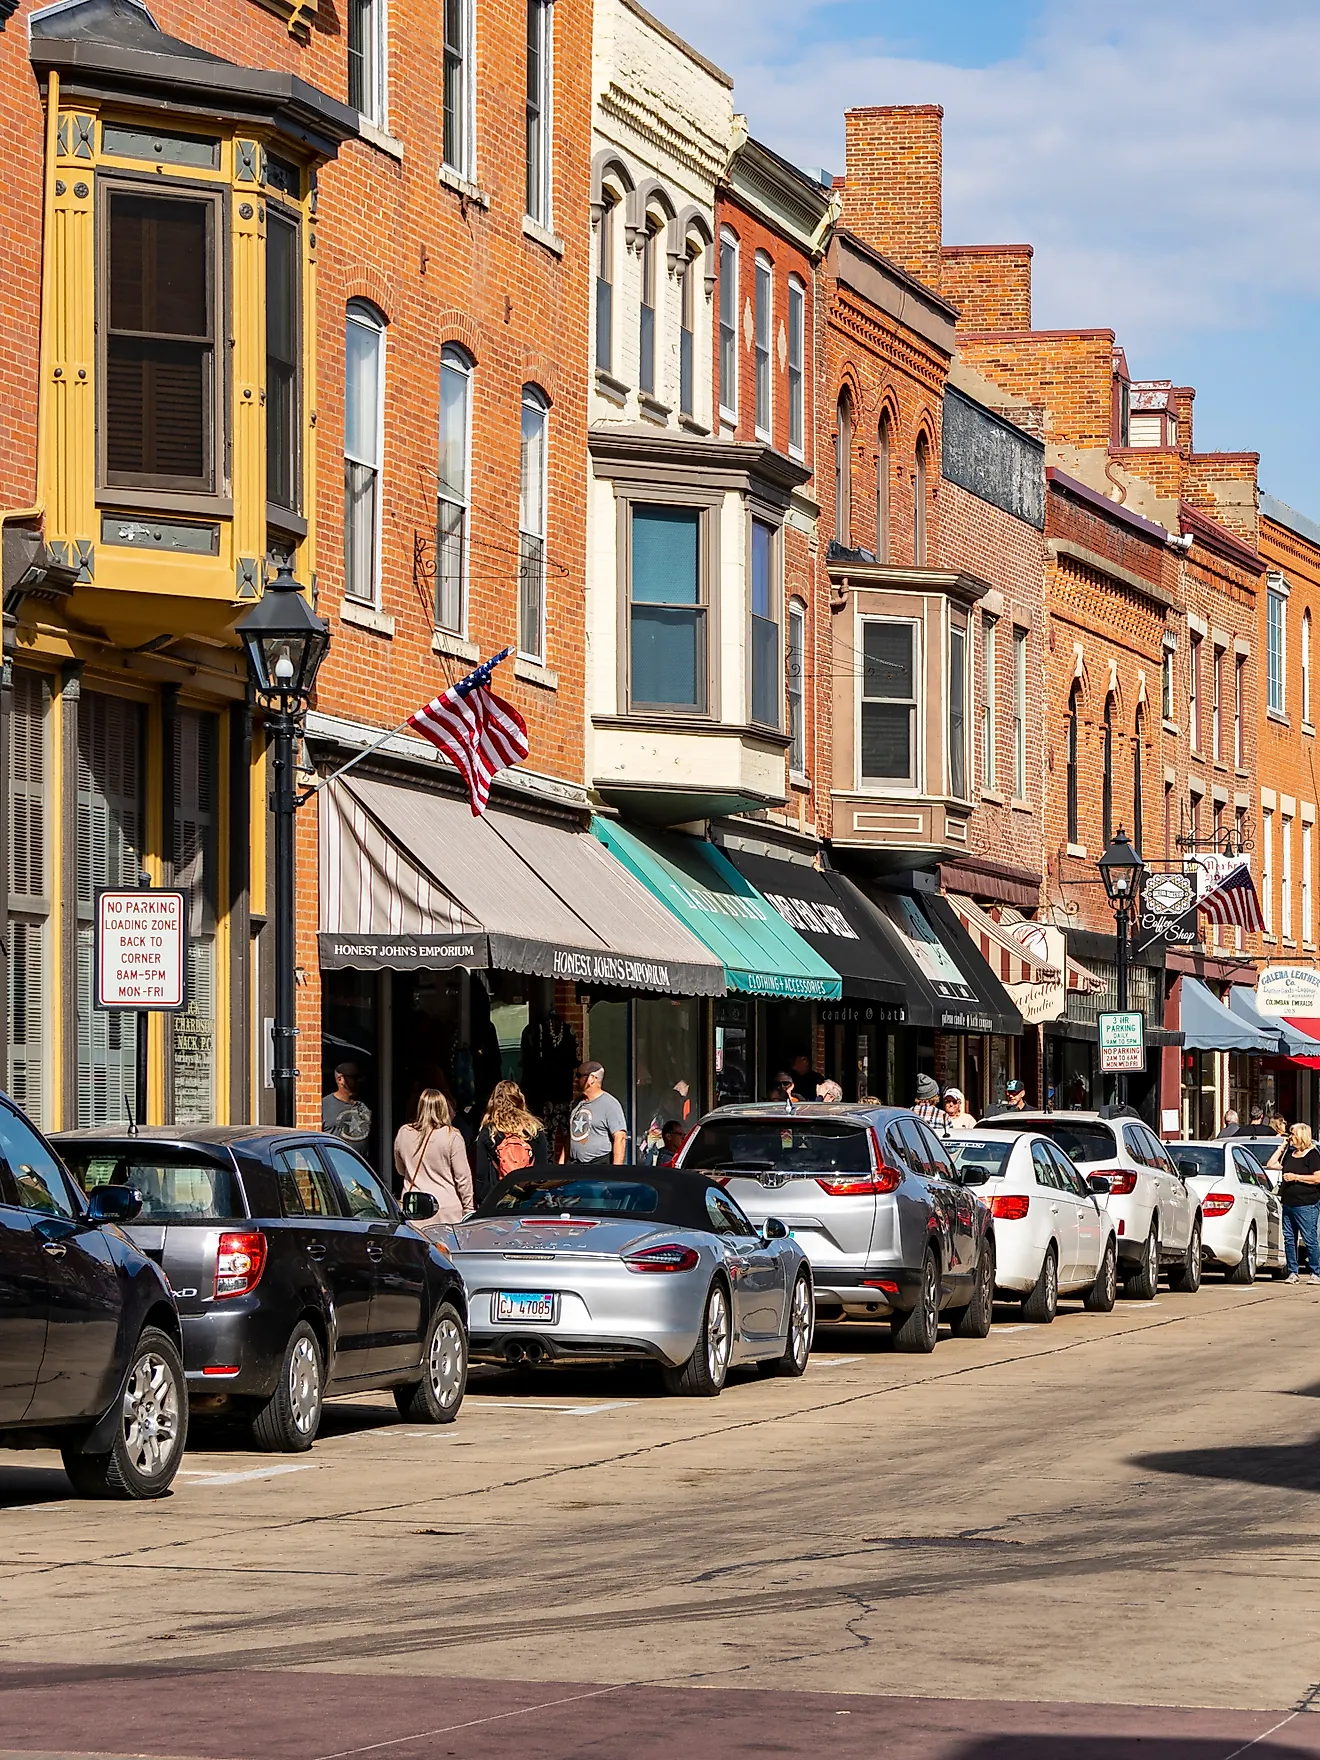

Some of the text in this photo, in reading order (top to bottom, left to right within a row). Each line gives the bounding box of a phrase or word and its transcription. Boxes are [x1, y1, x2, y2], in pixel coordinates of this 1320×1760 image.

[107, 902, 175, 913] NO PARKING
[670, 885, 767, 920] LADYBIRD
[105, 920, 177, 930] LOADING ZONE
[1142, 914, 1173, 933] Coffee
[1164, 925, 1195, 944] Shop
[120, 937, 163, 947] BACK TO
[334, 944, 474, 957] HONEST JOHN'S EMPORIUM
[121, 953, 161, 963] CORNER
[116, 970, 166, 980] 8AM-5PM
[553, 951, 592, 976] HONEST
[624, 960, 670, 986] EMPORIUM
[748, 975, 779, 990] CLOTHING
[784, 979, 826, 994] ACCESSORIES
[1262, 970, 1320, 987] GALENA LEATHER
[822, 1008, 858, 1020] candle
[880, 1008, 905, 1021] bath
[1113, 1047, 1140, 1055] PARKING
[501, 1300, 550, 1314] CJ 47085
